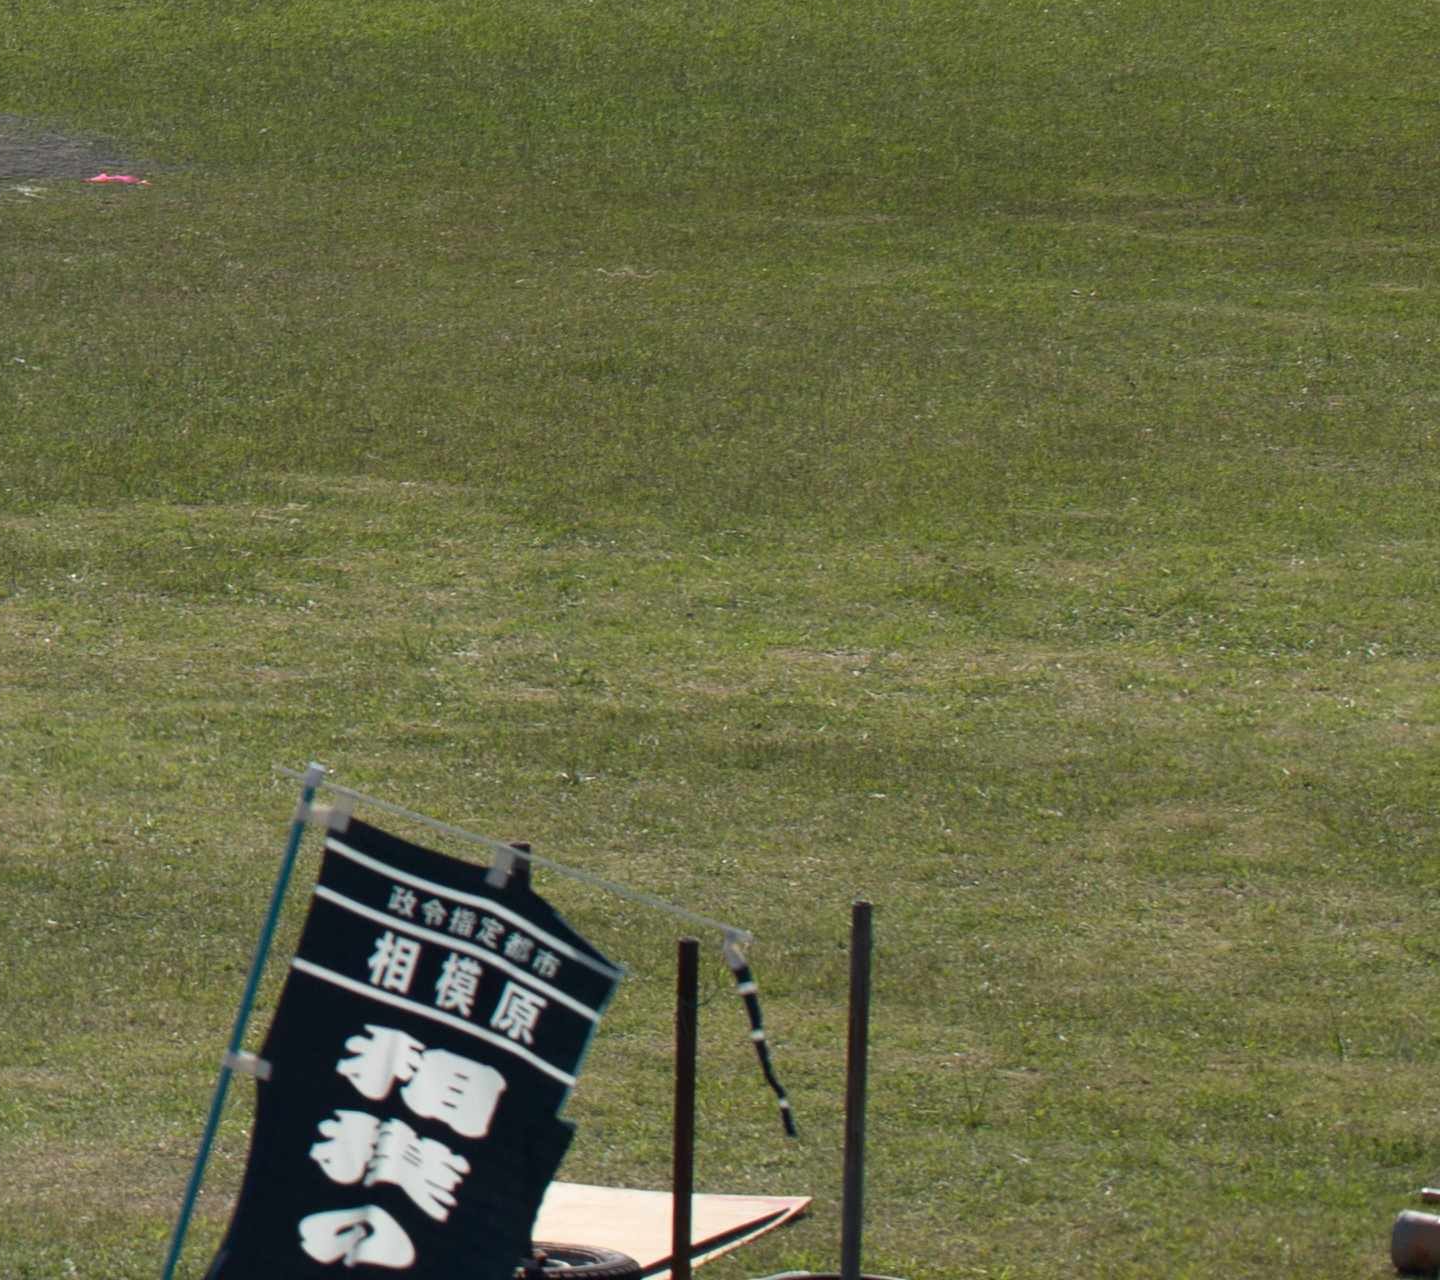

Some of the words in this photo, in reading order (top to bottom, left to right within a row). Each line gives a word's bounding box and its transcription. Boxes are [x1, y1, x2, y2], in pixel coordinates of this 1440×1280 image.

[387, 885, 562, 979] 政令指定都市
[367, 930, 548, 1046] 相模原
